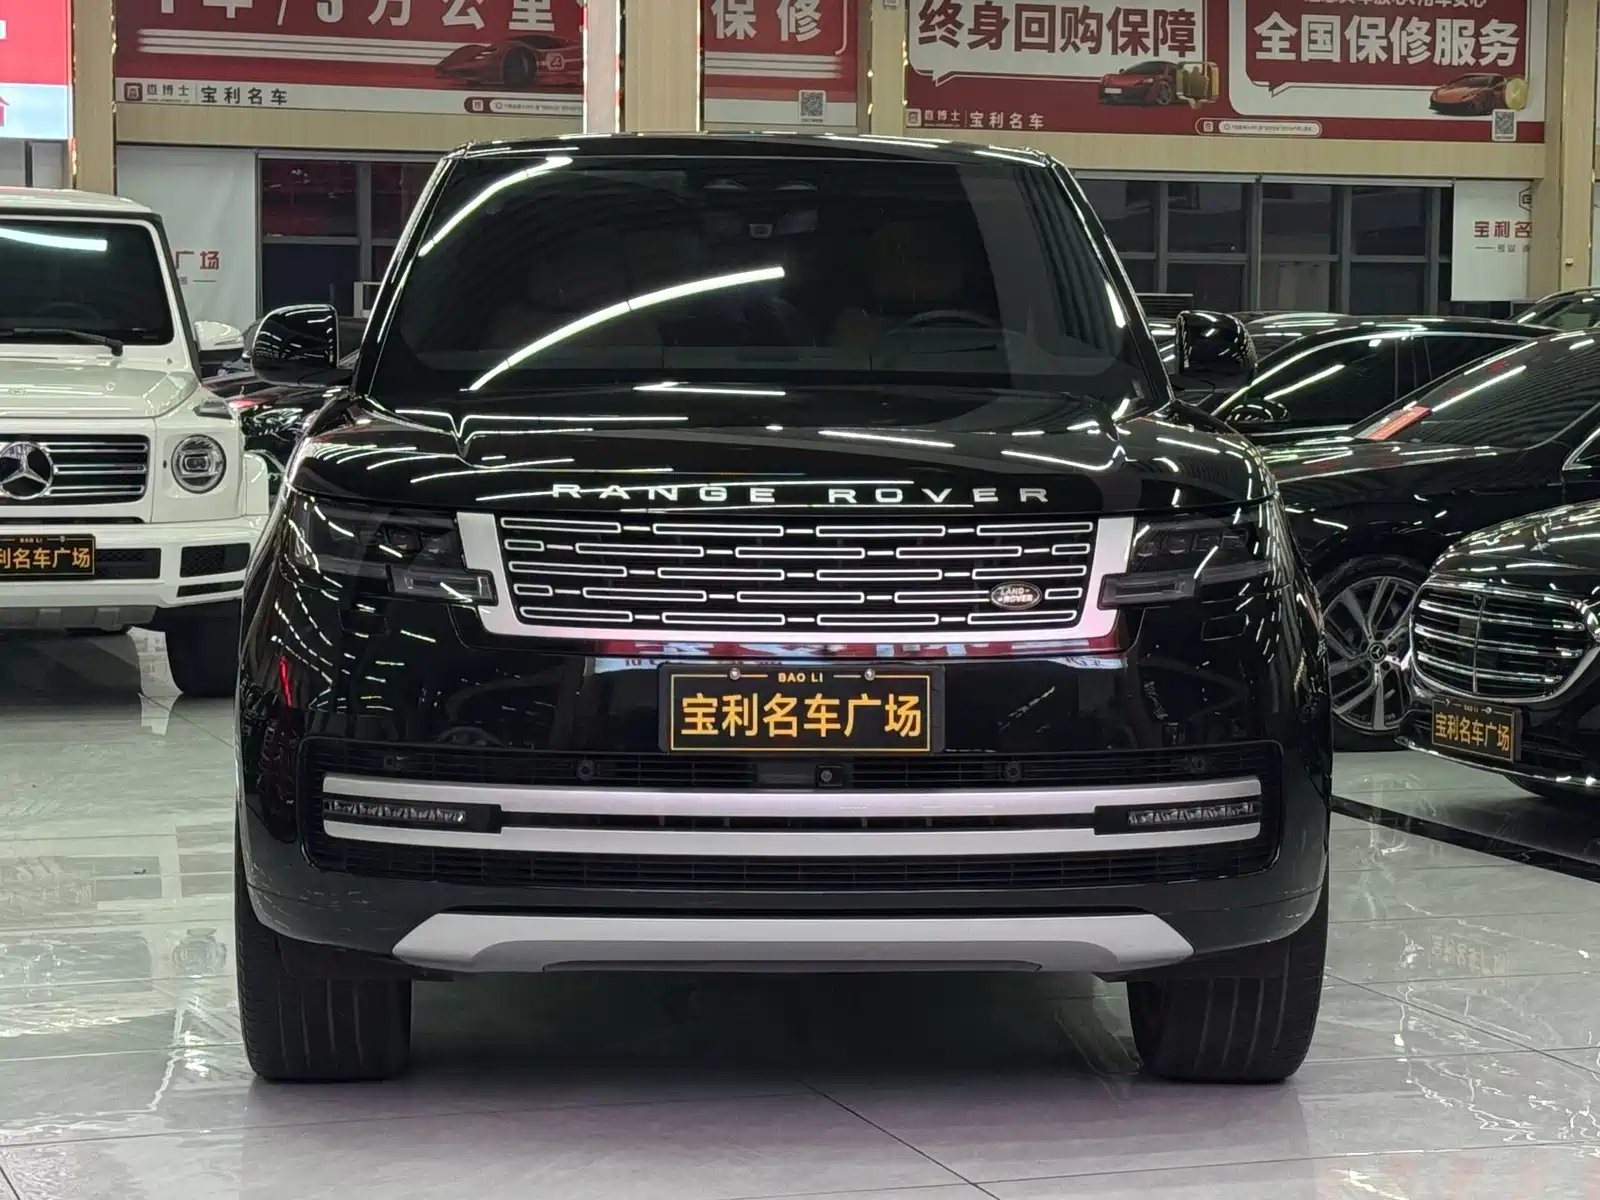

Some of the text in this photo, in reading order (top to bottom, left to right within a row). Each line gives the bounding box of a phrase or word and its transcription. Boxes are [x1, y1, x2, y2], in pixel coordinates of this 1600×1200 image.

[711, 0, 822, 42] 保修
[918, 0, 1197, 58] 终身回购保障
[1253, 11, 1521, 67] 全国保修服务
[201, 86, 288, 106] 宝利名车
[969, 111, 1044, 129] 宝利名车
[175, 250, 220, 270] 广场
[552, 483, 1049, 503] RANGE ROVER
[1001, 587, 1025, 595] LAND
[1003, 594, 1033, 602] ROVER
[778, 672, 824, 683] BAO LI
[681, 693, 922, 738] 宝利名车广场
[1435, 712, 1510, 751] 宝利名车广场
